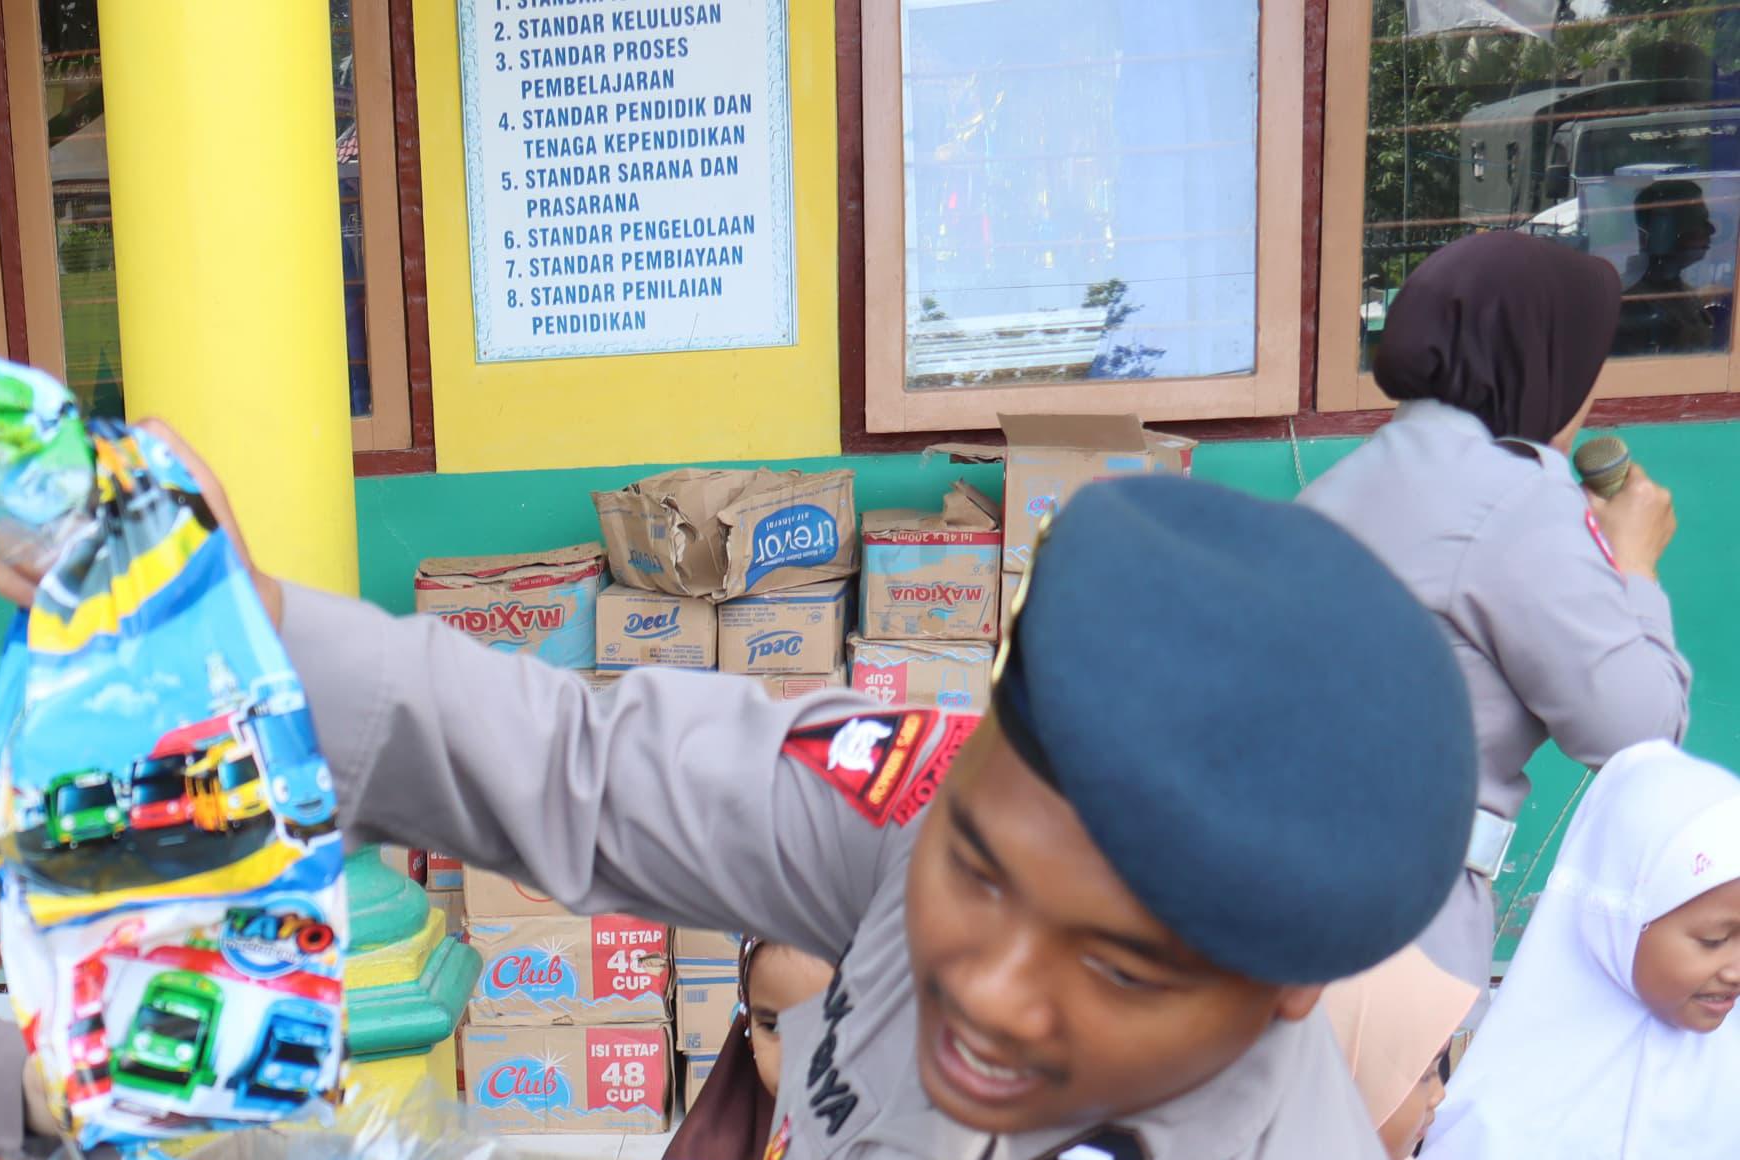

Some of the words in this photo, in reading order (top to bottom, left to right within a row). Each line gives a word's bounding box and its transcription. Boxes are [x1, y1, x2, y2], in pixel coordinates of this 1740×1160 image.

[494, 21, 511, 42] 2.
[518, 13, 604, 39] STANDAR
[612, 3, 721, 32] KELULUSAN
[495, 52, 512, 71] 3.
[520, 44, 606, 70] STANDAR
[613, 37, 688, 62] PROSES
[521, 69, 674, 99] PEMBELAJARAN
[499, 112, 515, 131] 4.
[522, 104, 608, 130] STANDAR
[616, 97, 706, 123] PENDIDIK
[713, 94, 752, 116] DAN
[523, 136, 597, 160] TENAGA
[604, 125, 746, 155] KEPENDIDIKAN
[501, 171, 518, 191] 5.
[525, 164, 610, 189] STANDAR
[618, 158, 693, 183] SARANA
[701, 156, 739, 177] DAN
[527, 192, 640, 218] PRASARANA
[504, 231, 521, 250] 6.
[528, 224, 613, 248] STANDAR
[620, 214, 755, 242] PENGELOLAAN
[505, 259, 523, 279] 7.
[529, 253, 614, 278] STANDAR
[621, 245, 744, 272] PEMBIAYAAN
[507, 289, 524, 308] 8.
[531, 283, 615, 307] STANDAR
[623, 276, 722, 301] PENILAIAN
[532, 310, 646, 336] PENDIDIKAN
[756, 519, 836, 564] trevor
[943, 532, 956, 542] 48
[624, 606, 680, 633] Deal
[748, 635, 803, 665] Deal
[865, 673, 893, 684] CUP
[226, 907, 335, 955] TAYO
[596, 932, 615, 946] ISI
[620, 930, 662, 945] TETAP
[491, 954, 563, 989] Club
[612, 975, 652, 991] CUP
[591, 1044, 609, 1057] ISI
[614, 1044, 659, 1057] TETAP
[487, 1065, 557, 1099] Club
[601, 1062, 645, 1087] 48
[606, 1089, 645, 1102] CUP
